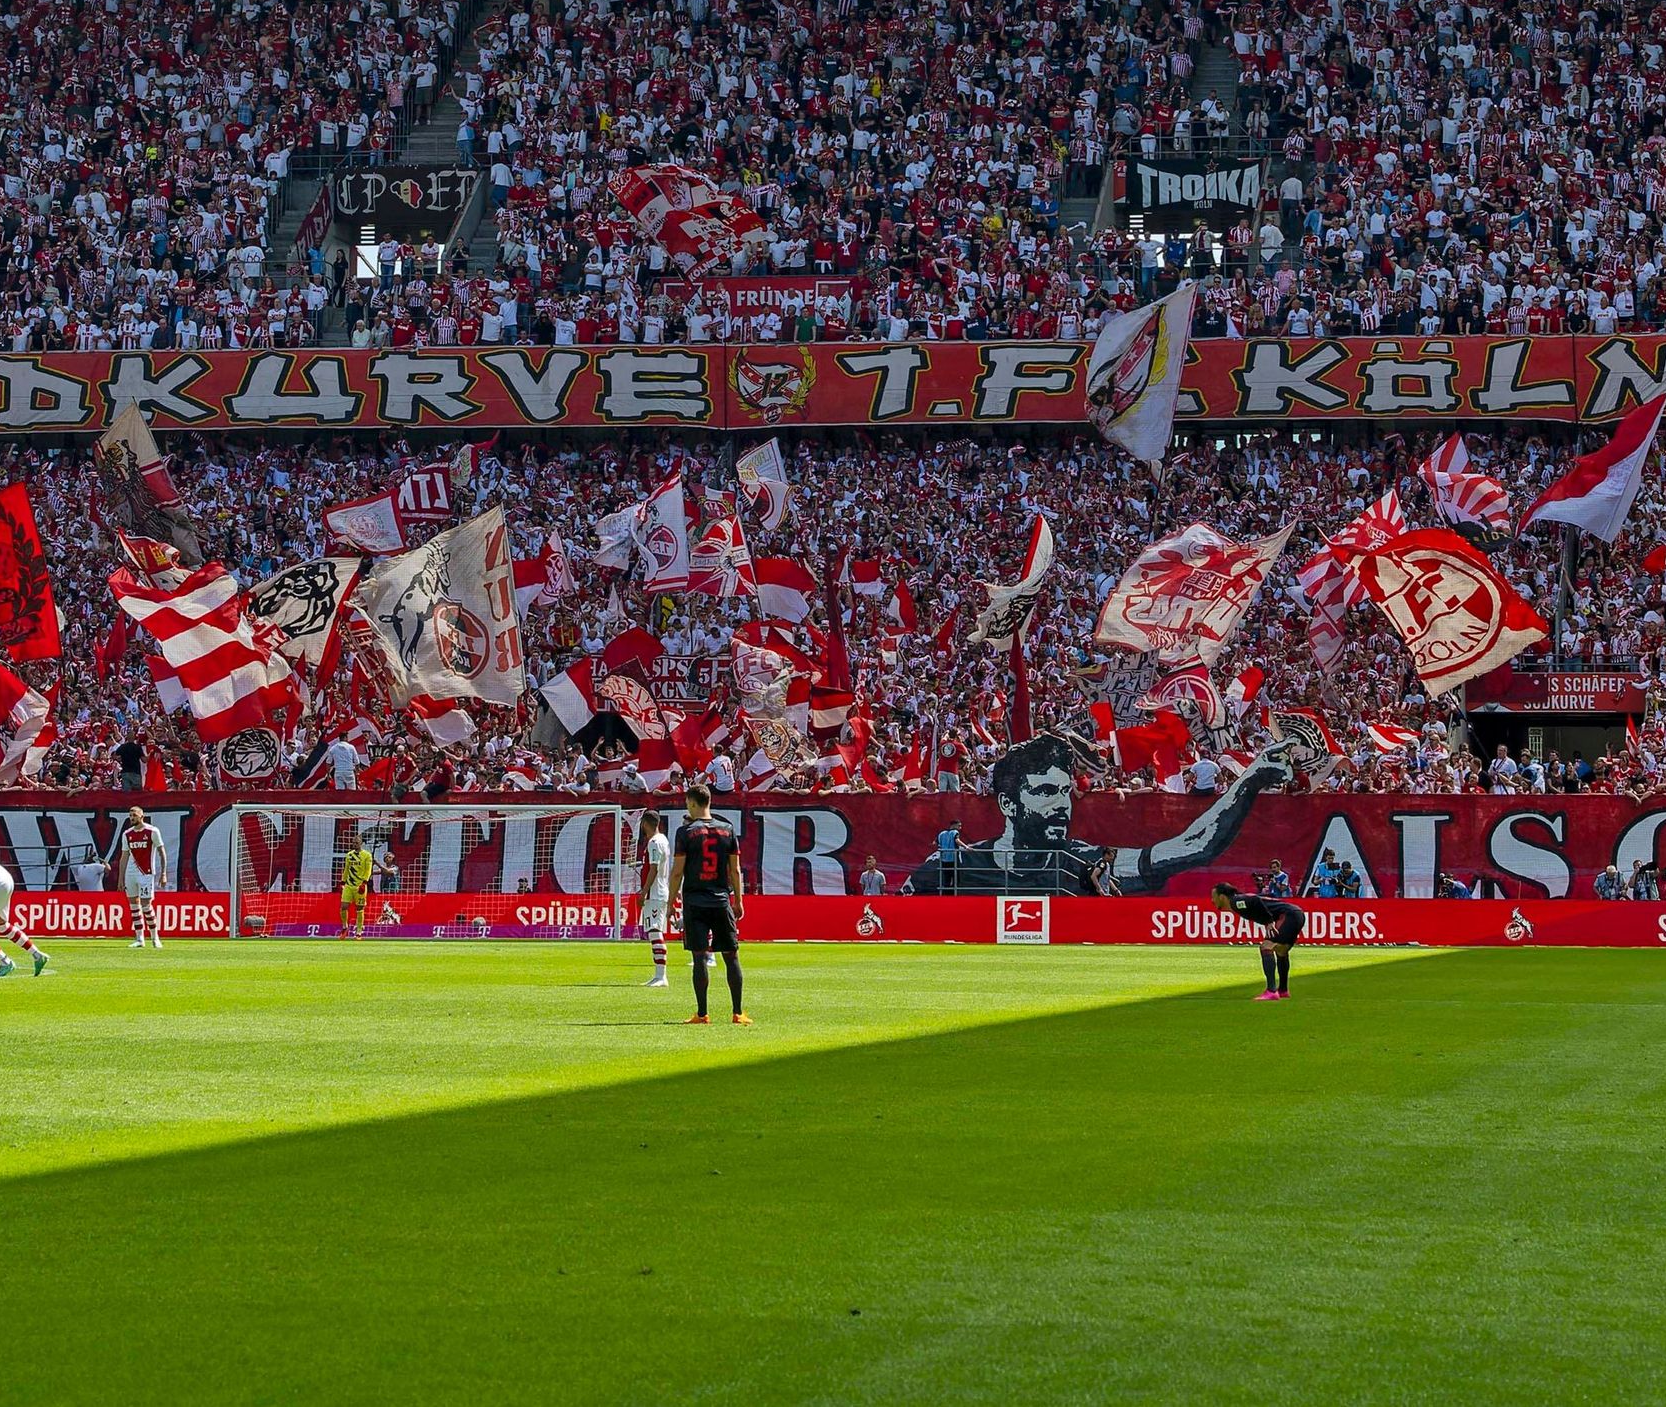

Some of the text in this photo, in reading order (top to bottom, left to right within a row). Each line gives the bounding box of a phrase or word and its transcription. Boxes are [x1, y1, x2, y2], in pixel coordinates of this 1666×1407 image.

[1137, 162, 1261, 209] TROIKA
[736, 286, 815, 307] FRÜNE
[702, 838, 718, 873] 5
[1299, 809, 1573, 899] ALS
[15, 899, 230, 931] SPÜRBAR NDERS.
[1301, 911, 1384, 940] NDERS.
